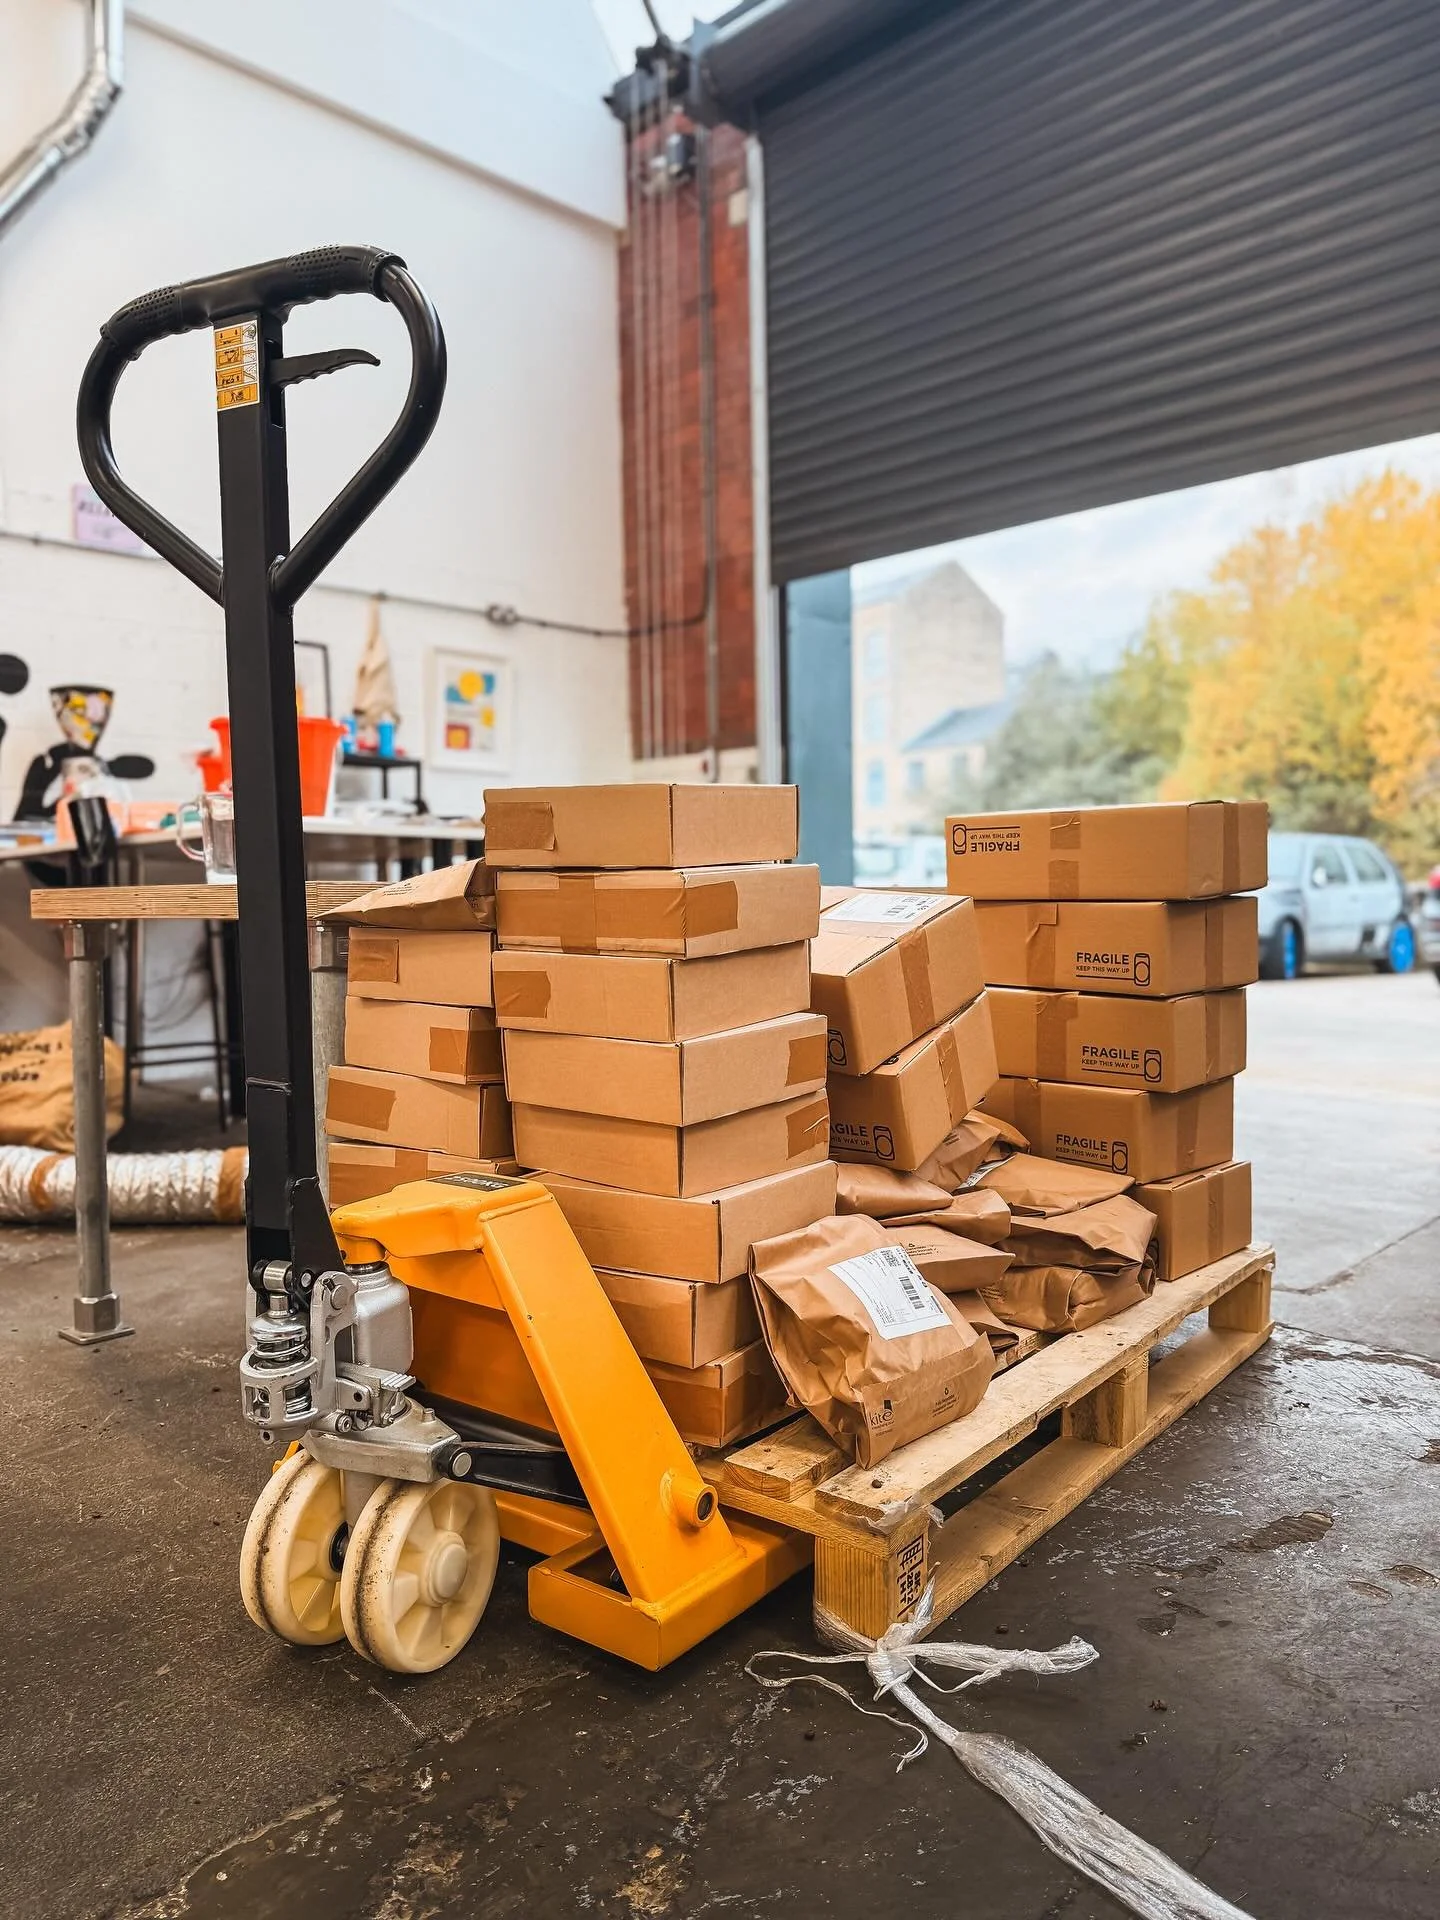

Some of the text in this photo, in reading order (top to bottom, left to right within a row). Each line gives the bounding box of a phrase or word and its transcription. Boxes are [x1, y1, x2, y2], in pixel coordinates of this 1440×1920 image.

[971, 841, 1020, 852] FRAGILE
[1076, 952, 1130, 965] FRAGILE
[1082, 1046, 1140, 1061] FRAGILE
[1056, 1133, 1108, 1152] FRAGILE
[1055, 1146, 1070, 1154] KEEP
[1085, 1151, 1099, 1159] WAY
[900, 1580, 907, 1604] HT
